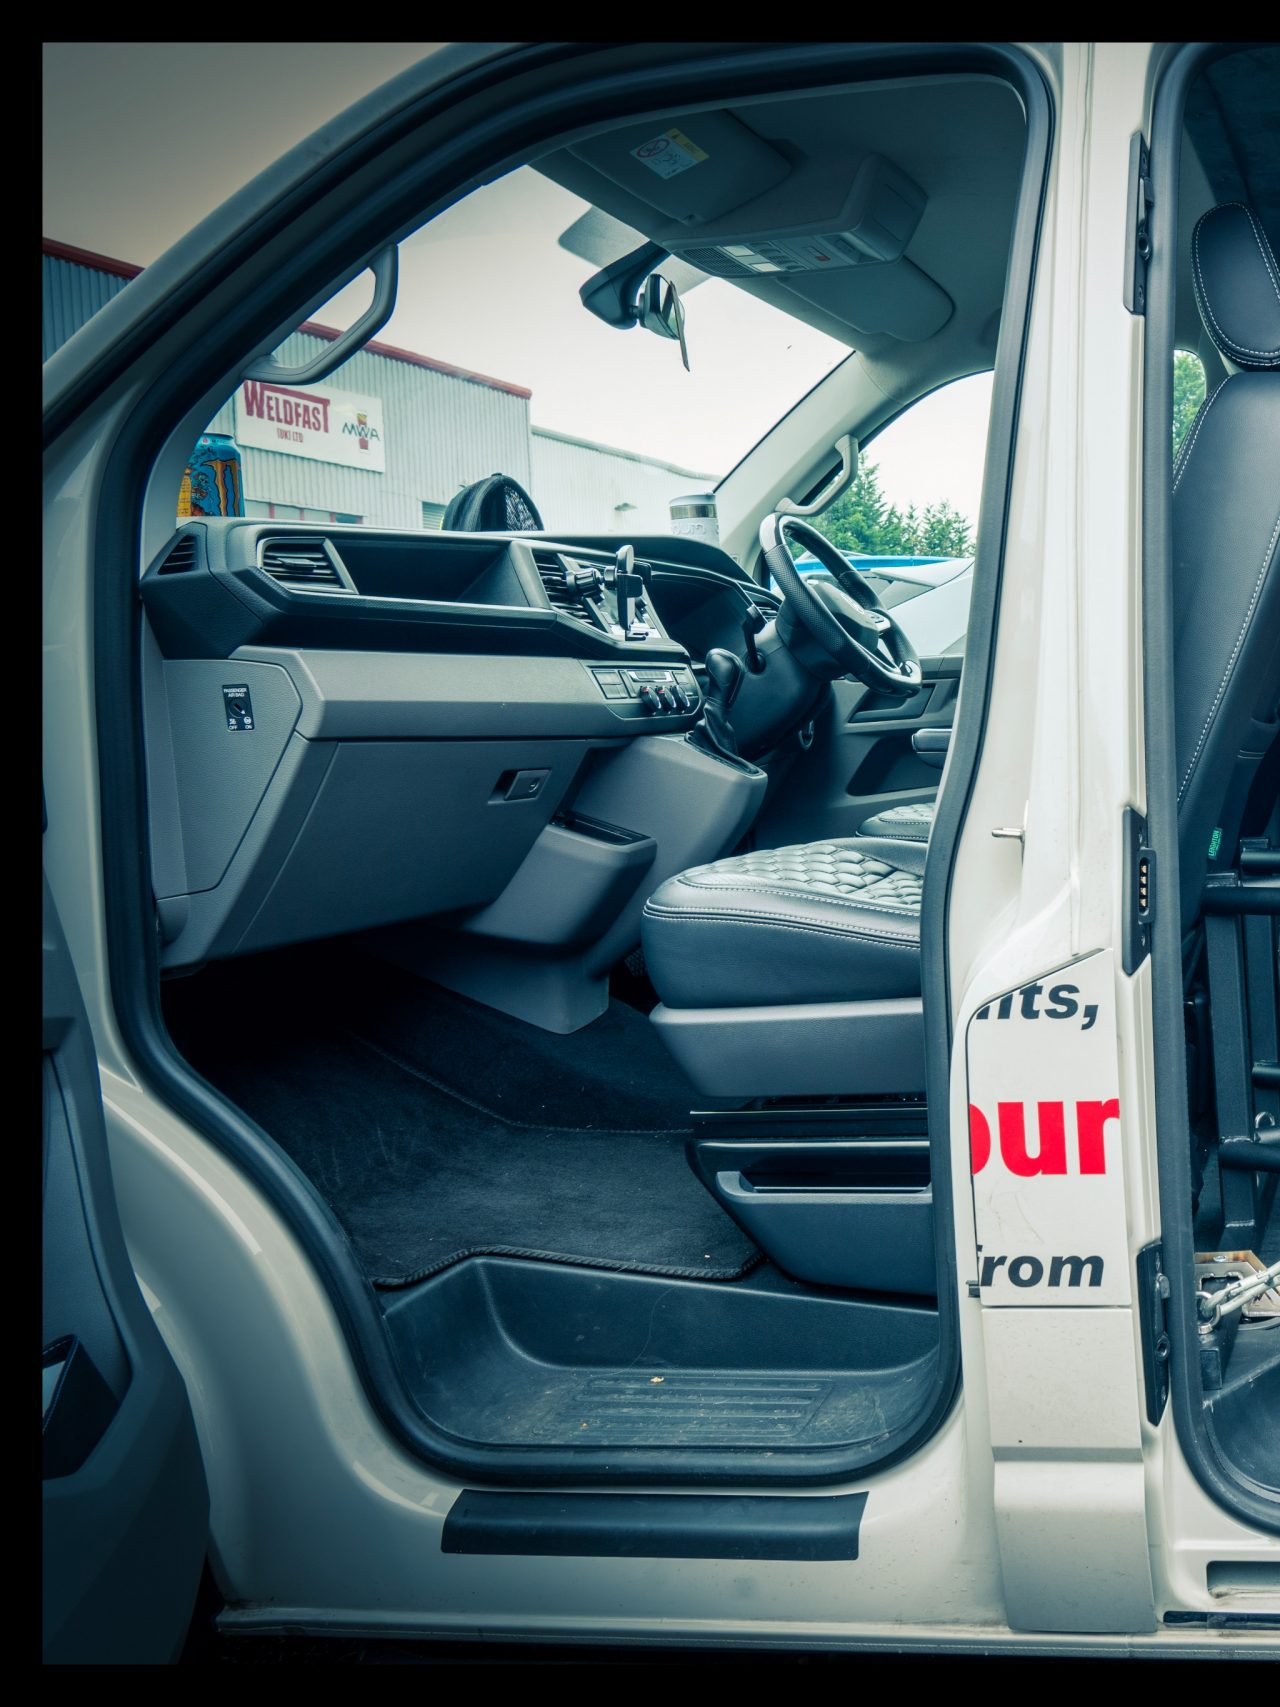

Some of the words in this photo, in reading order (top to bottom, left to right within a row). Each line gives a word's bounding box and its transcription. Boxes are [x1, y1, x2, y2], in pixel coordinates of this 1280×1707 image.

[243, 380, 331, 433] WELDFAST
[342, 422, 381, 442] MWA
[977, 1245, 1105, 1288] rom
